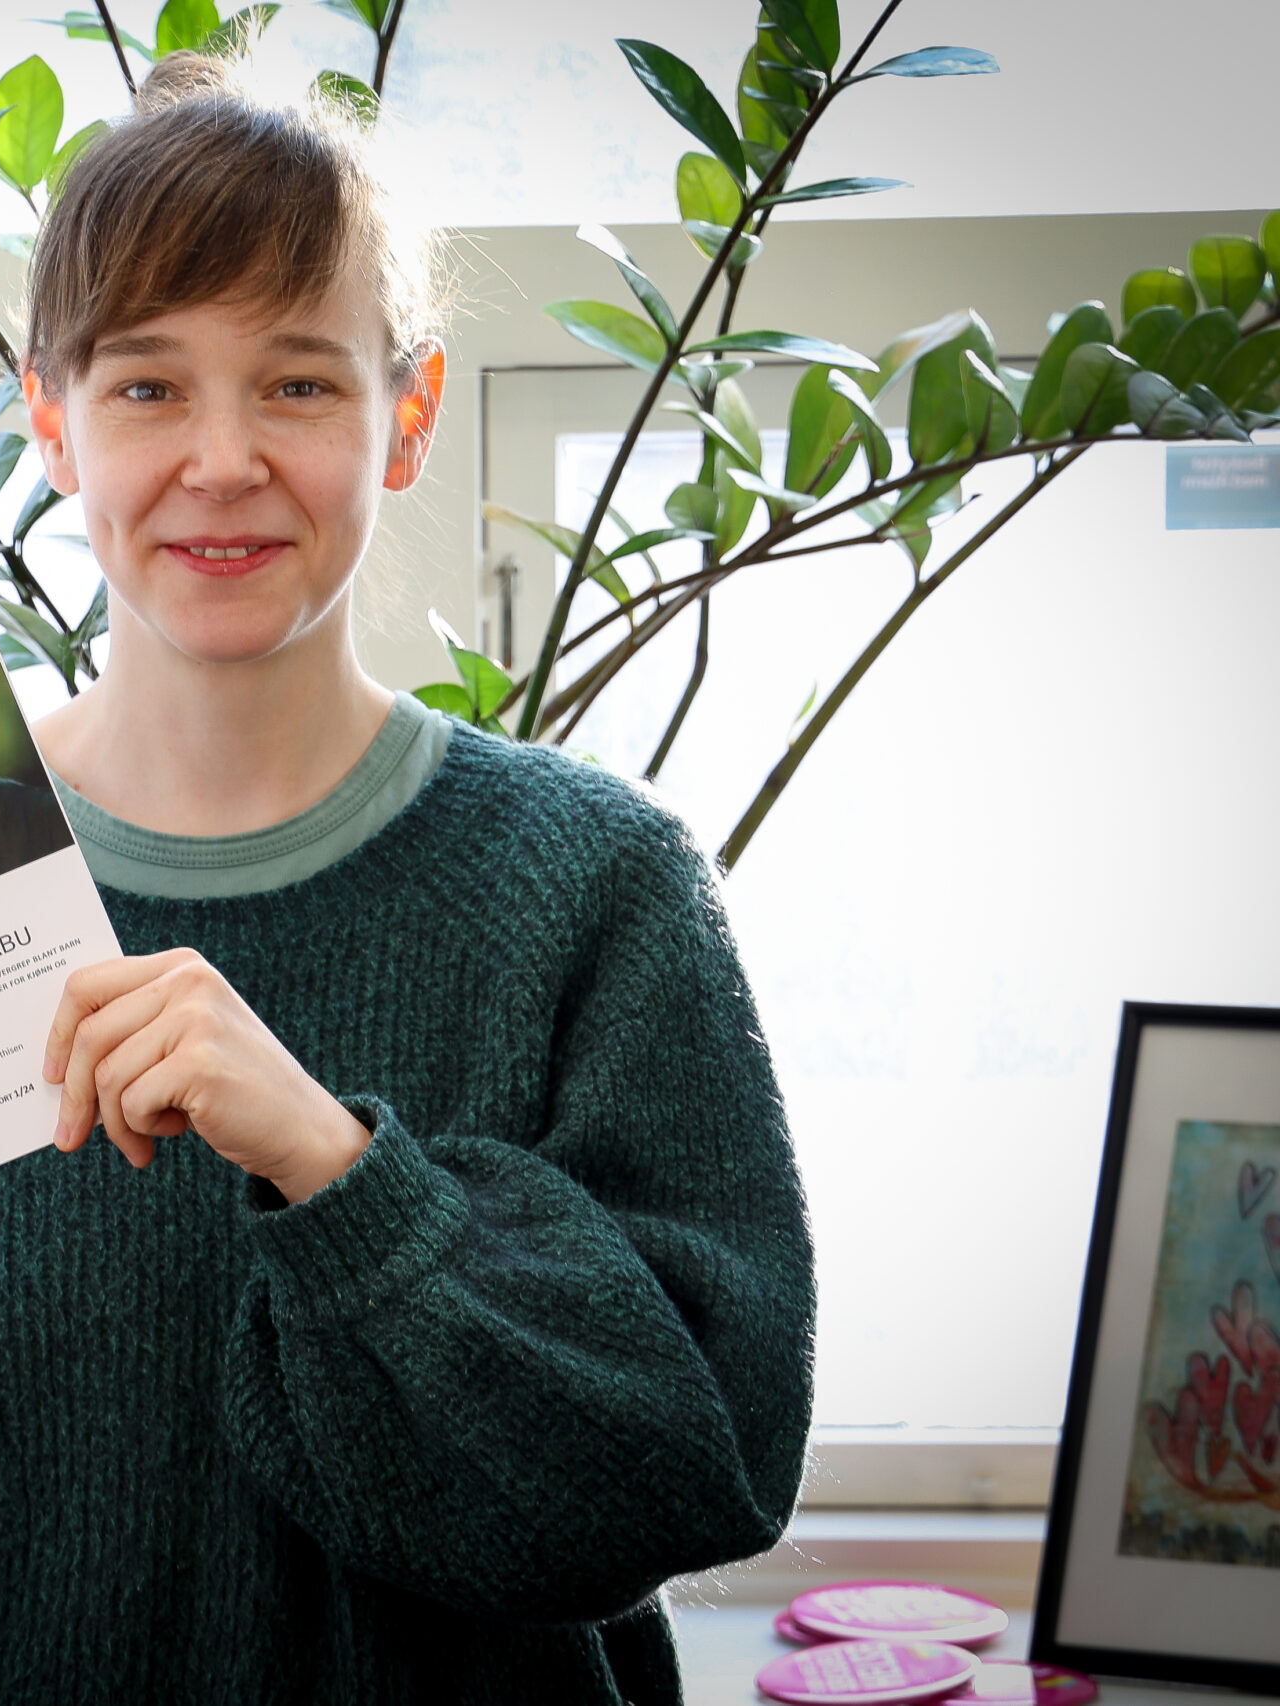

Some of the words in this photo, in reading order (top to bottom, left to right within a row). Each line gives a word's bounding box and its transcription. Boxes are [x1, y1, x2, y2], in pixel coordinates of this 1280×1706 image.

[32, 947, 58, 963] BLANT
[59, 938, 81, 953] BARN
[9, 975, 26, 988] FOR
[26, 965, 53, 981] KJØNN
[54, 958, 67, 969] OG
[13, 1083, 35, 1098] 1/24
